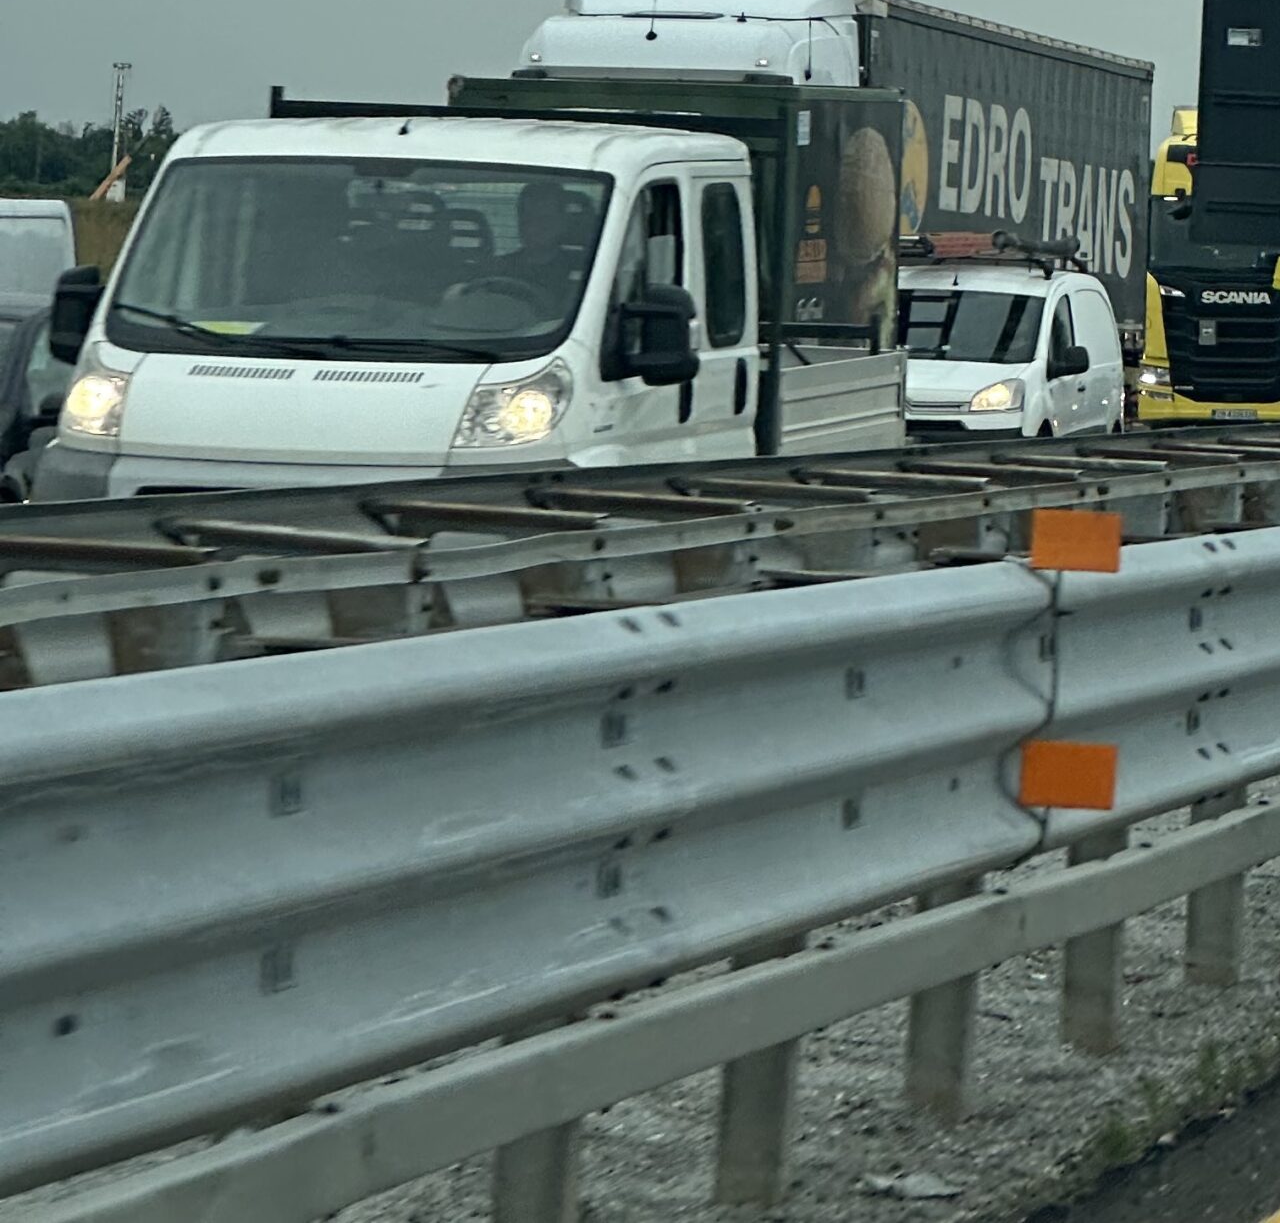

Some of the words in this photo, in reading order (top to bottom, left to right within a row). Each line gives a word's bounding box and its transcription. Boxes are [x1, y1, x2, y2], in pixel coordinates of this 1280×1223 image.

[938, 94, 1033, 224] EDRO
[1040, 157, 1135, 279] TRANS
[1201, 290, 1271, 305] SCANIA
